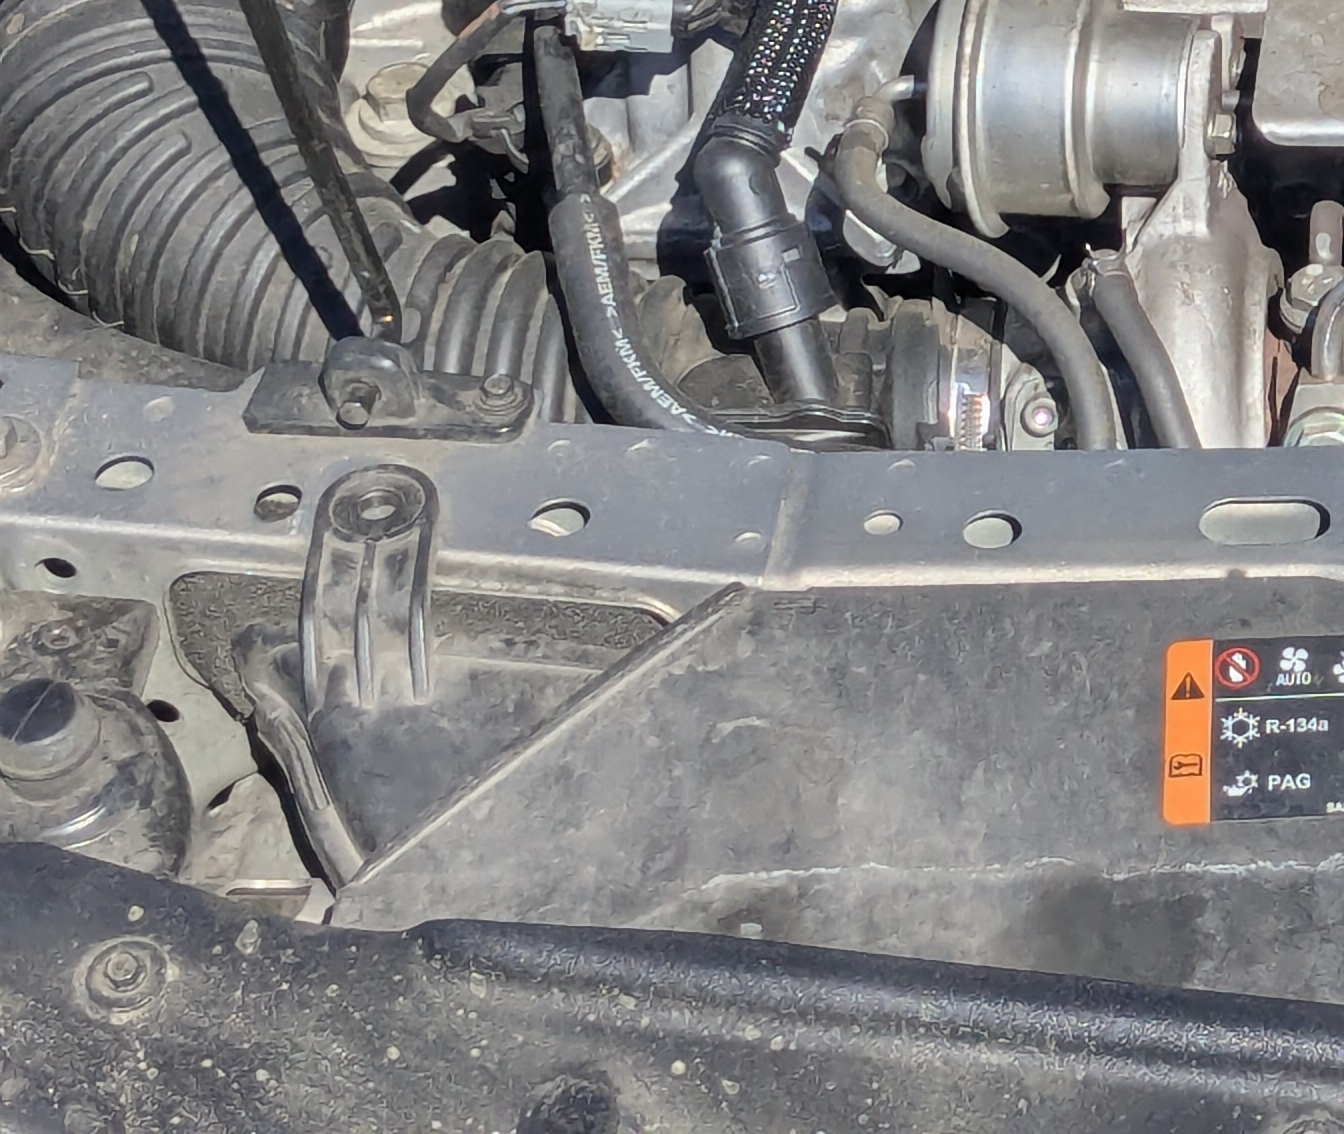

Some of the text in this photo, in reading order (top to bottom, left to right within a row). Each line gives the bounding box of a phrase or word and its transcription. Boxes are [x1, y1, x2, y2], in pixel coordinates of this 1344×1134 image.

[1276, 671, 1312, 687] AUTO
[1265, 717, 1329, 733] R-134a
[1267, 772, 1312, 791] PAG
